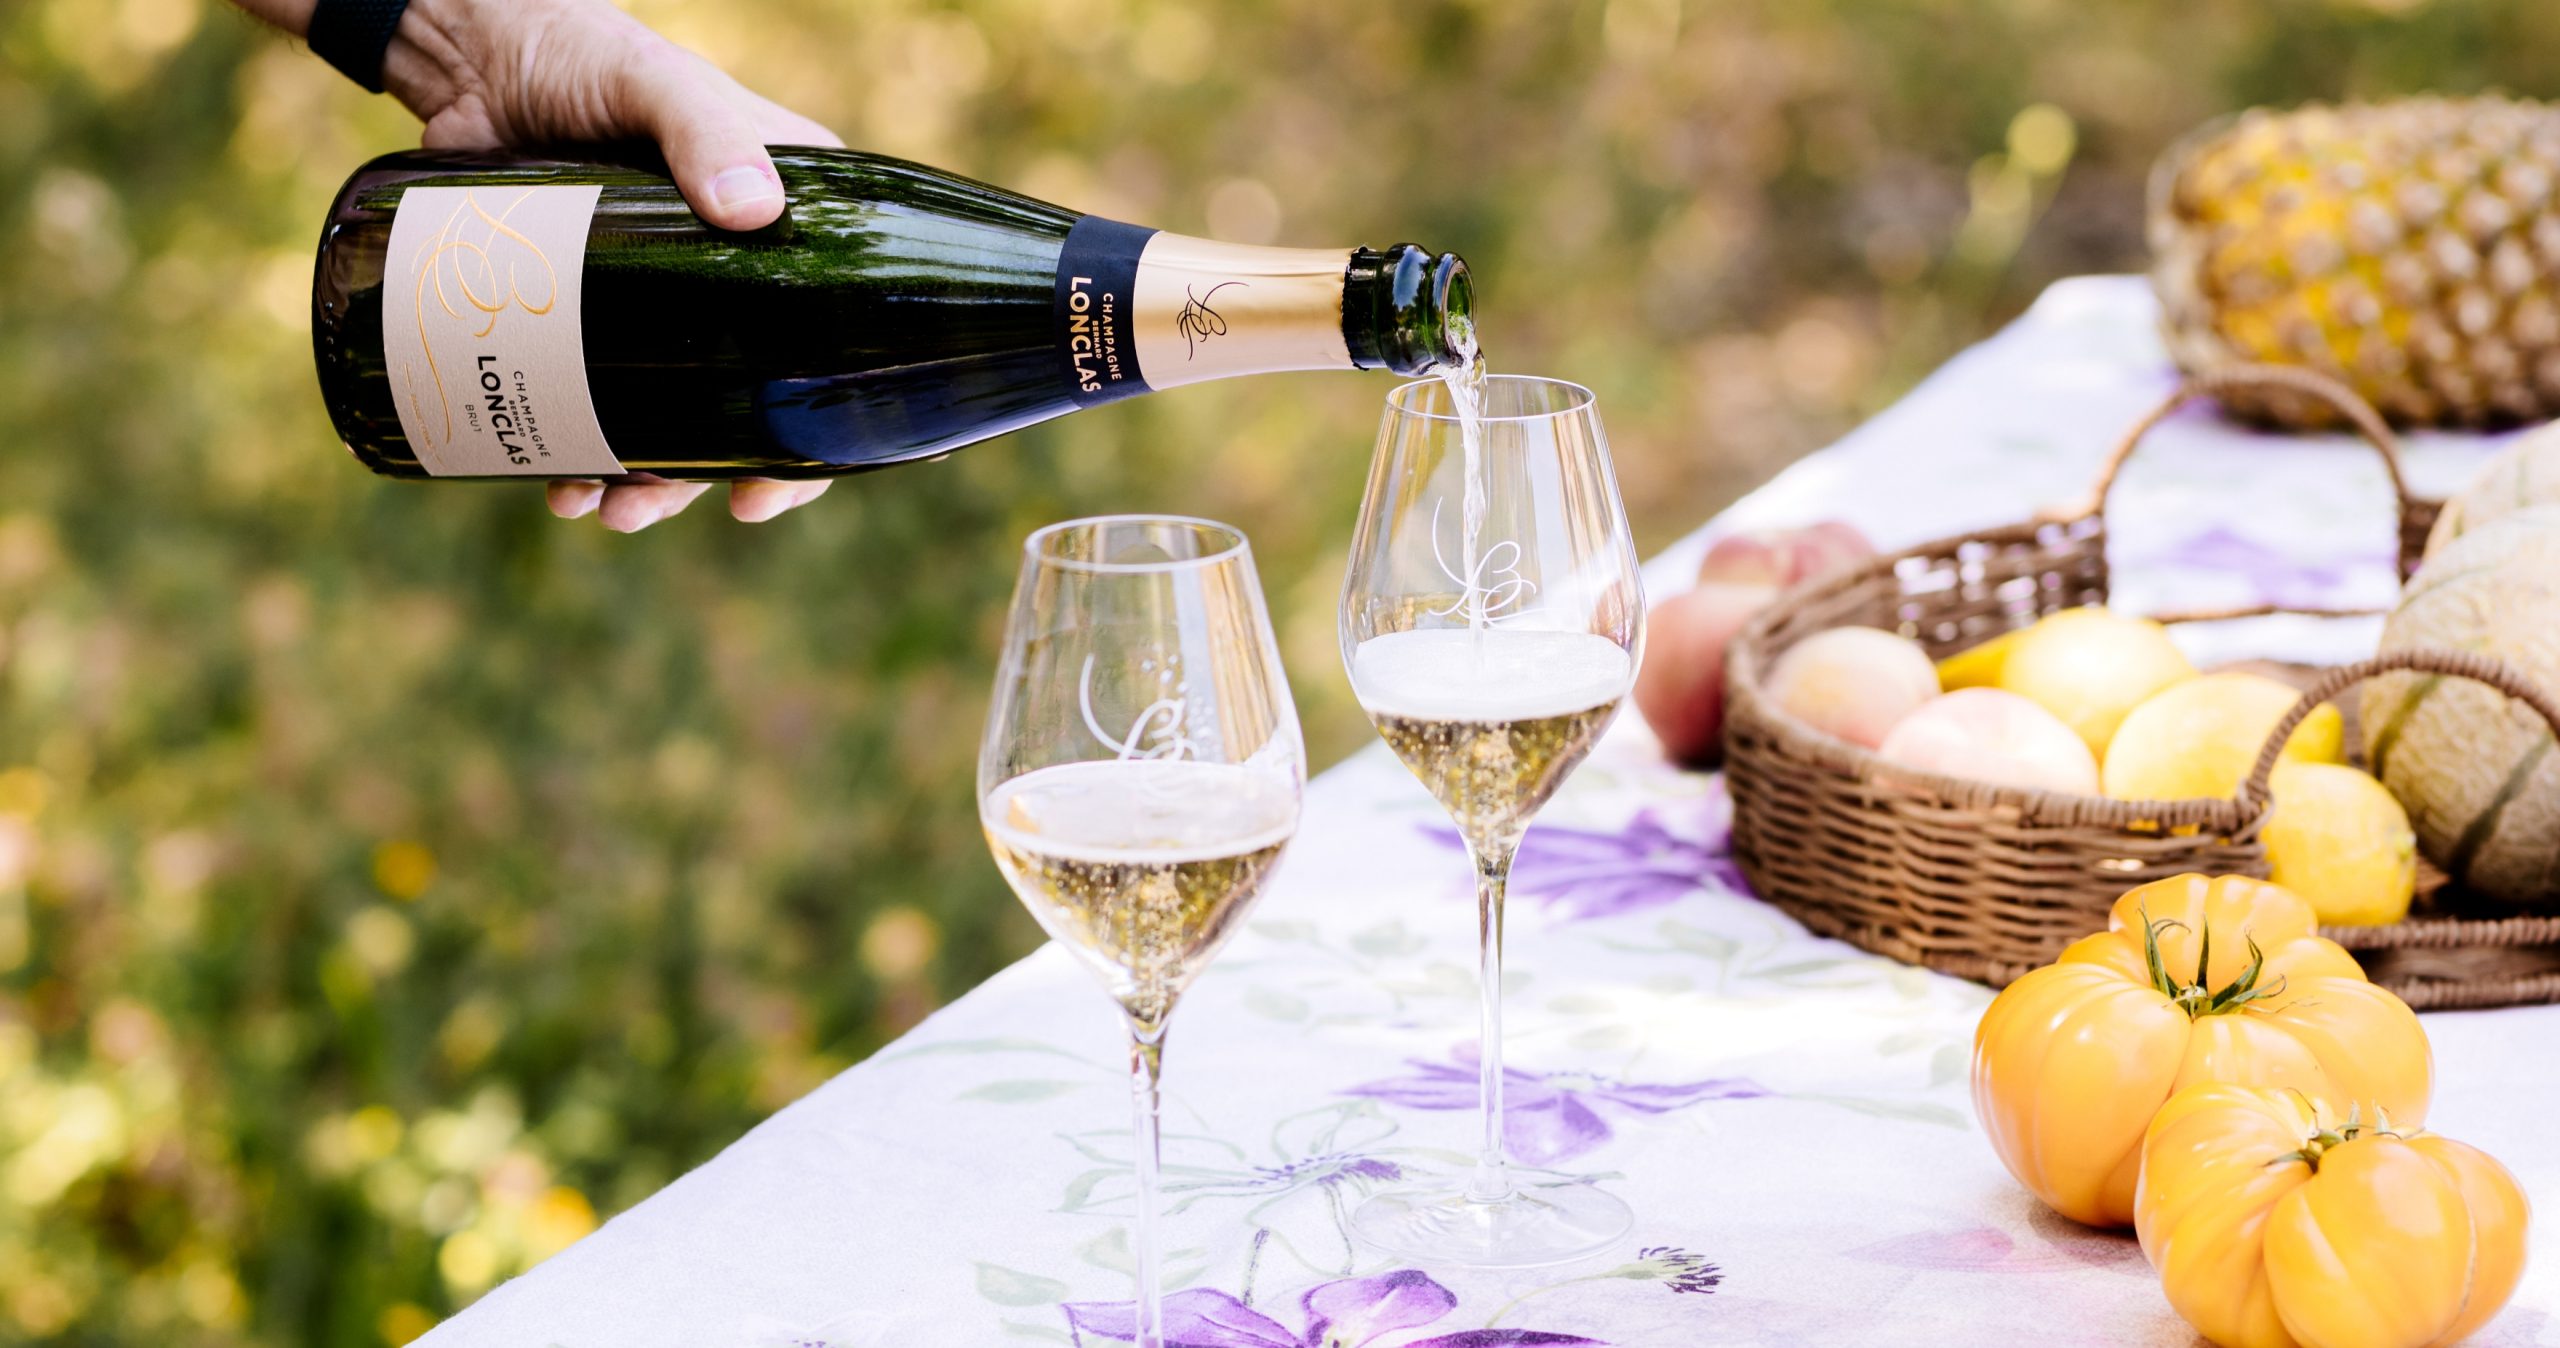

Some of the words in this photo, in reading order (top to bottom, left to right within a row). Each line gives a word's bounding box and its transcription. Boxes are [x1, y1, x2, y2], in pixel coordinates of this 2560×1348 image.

[1069, 276, 1102, 393] LONCLAS
[1091, 320, 1103, 359] BERNARD
[1102, 292, 1122, 381] CHAMPAGNE
[464, 404, 482, 433] BRUT
[477, 355, 532, 465] LONCLAS
[508, 399, 526, 438] BERNARD
[513, 370, 551, 457] CHAMPAGNE
